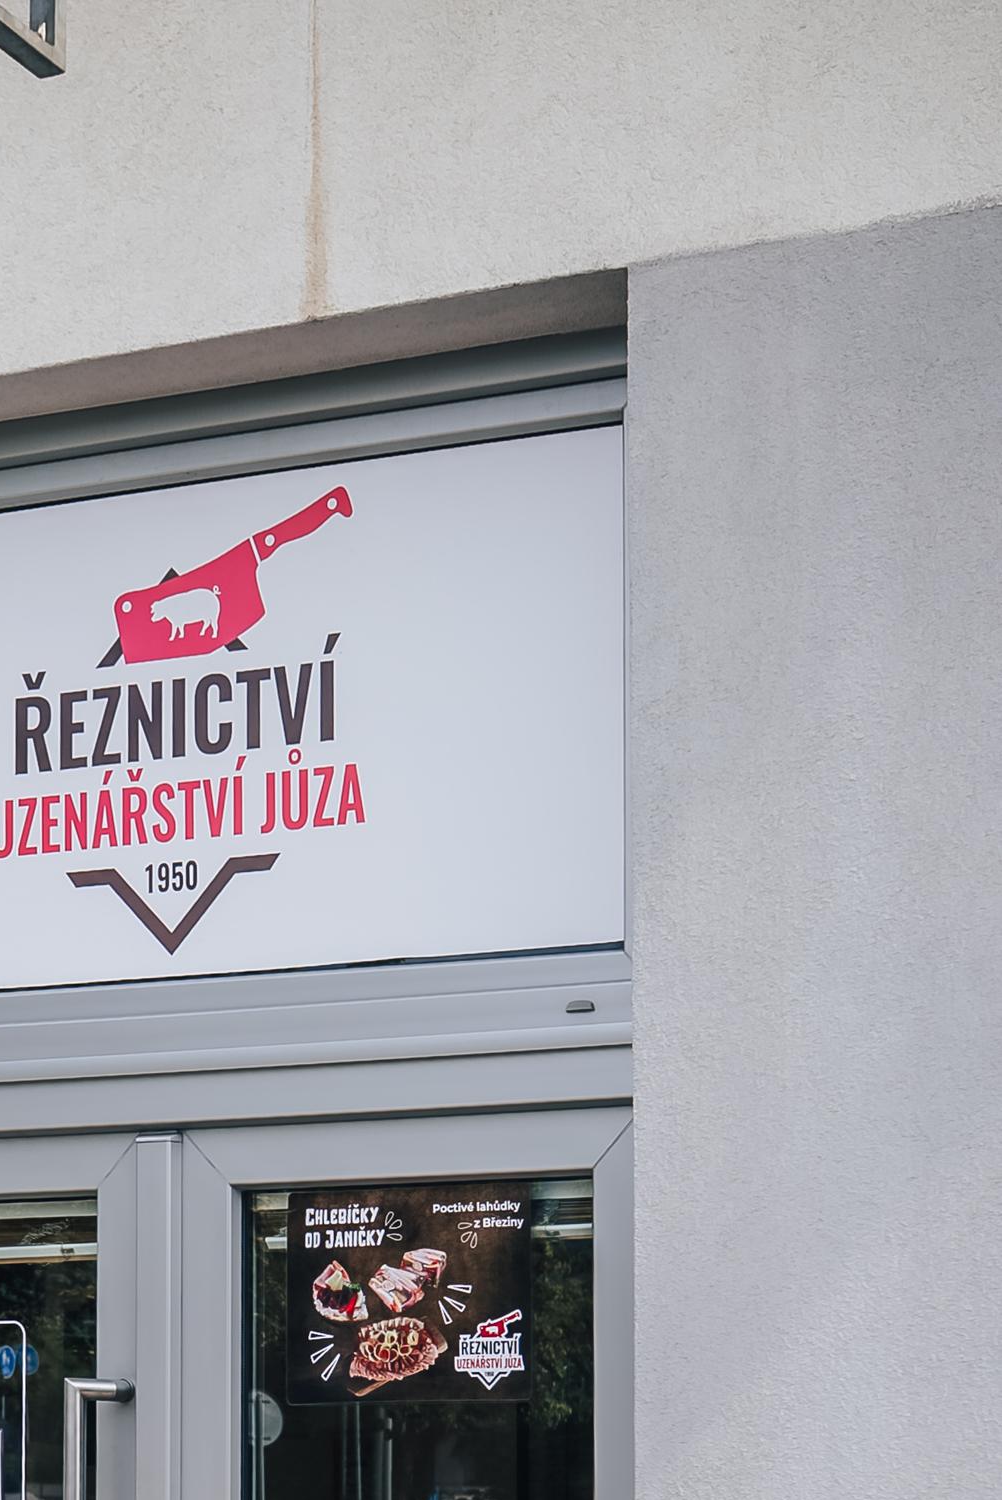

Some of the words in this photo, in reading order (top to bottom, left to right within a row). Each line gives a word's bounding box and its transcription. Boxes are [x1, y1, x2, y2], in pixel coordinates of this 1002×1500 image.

[14, 632, 341, 776] ŘEZNICTVÍ
[260, 748, 366, 835] JŮZA
[144, 861, 199, 893] 1950
[432, 1202, 474, 1213] Poctivé
[476, 1200, 520, 1212] lahůdky
[474, 1220, 480, 1228] z
[482, 1216, 524, 1229] Březiny
[461, 1335, 518, 1355] ŘEZNICTVÍ
[458, 1355, 502, 1368] UZENÁŘSTVÍ
[504, 1355, 522, 1368] JŮZA
